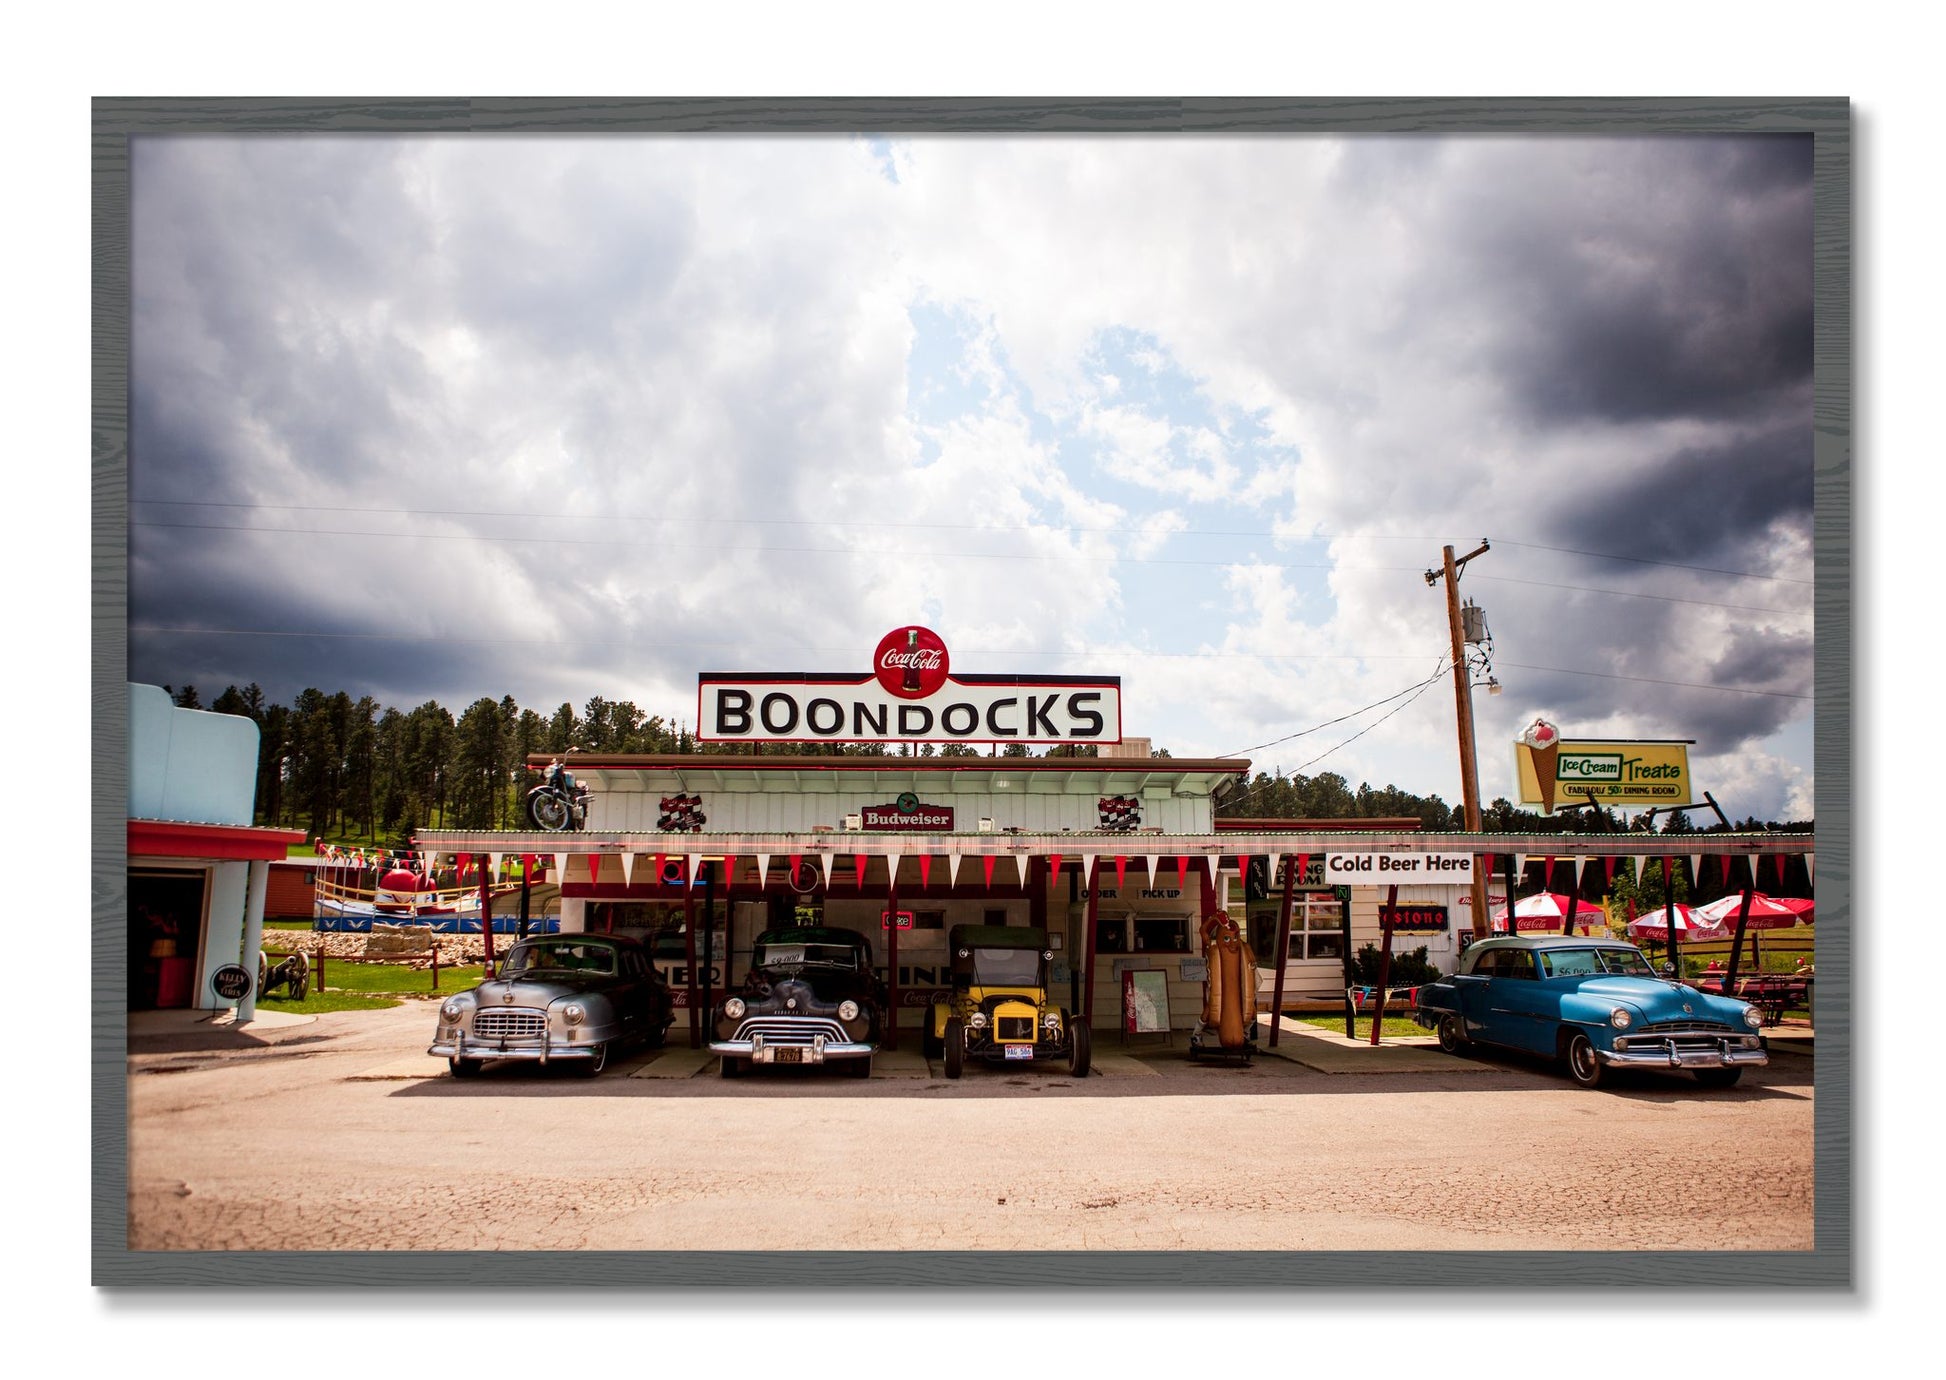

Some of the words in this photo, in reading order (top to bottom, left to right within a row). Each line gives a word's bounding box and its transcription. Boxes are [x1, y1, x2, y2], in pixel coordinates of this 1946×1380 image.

[716, 689, 1104, 737] BOONDOCKS
[1562, 759, 1579, 773] Ice
[1579, 759, 1617, 775] Cream
[1624, 758, 1681, 781] Treats
[1652, 787, 1675, 795] ROOM
[866, 812, 949, 825] Budweiser
[1330, 856, 1372, 871] Cold
[1379, 856, 1420, 871] Beer
[1426, 855, 1470, 871] Here
[1142, 889, 1165, 898] PICK
[1167, 890, 1181, 898] UP
